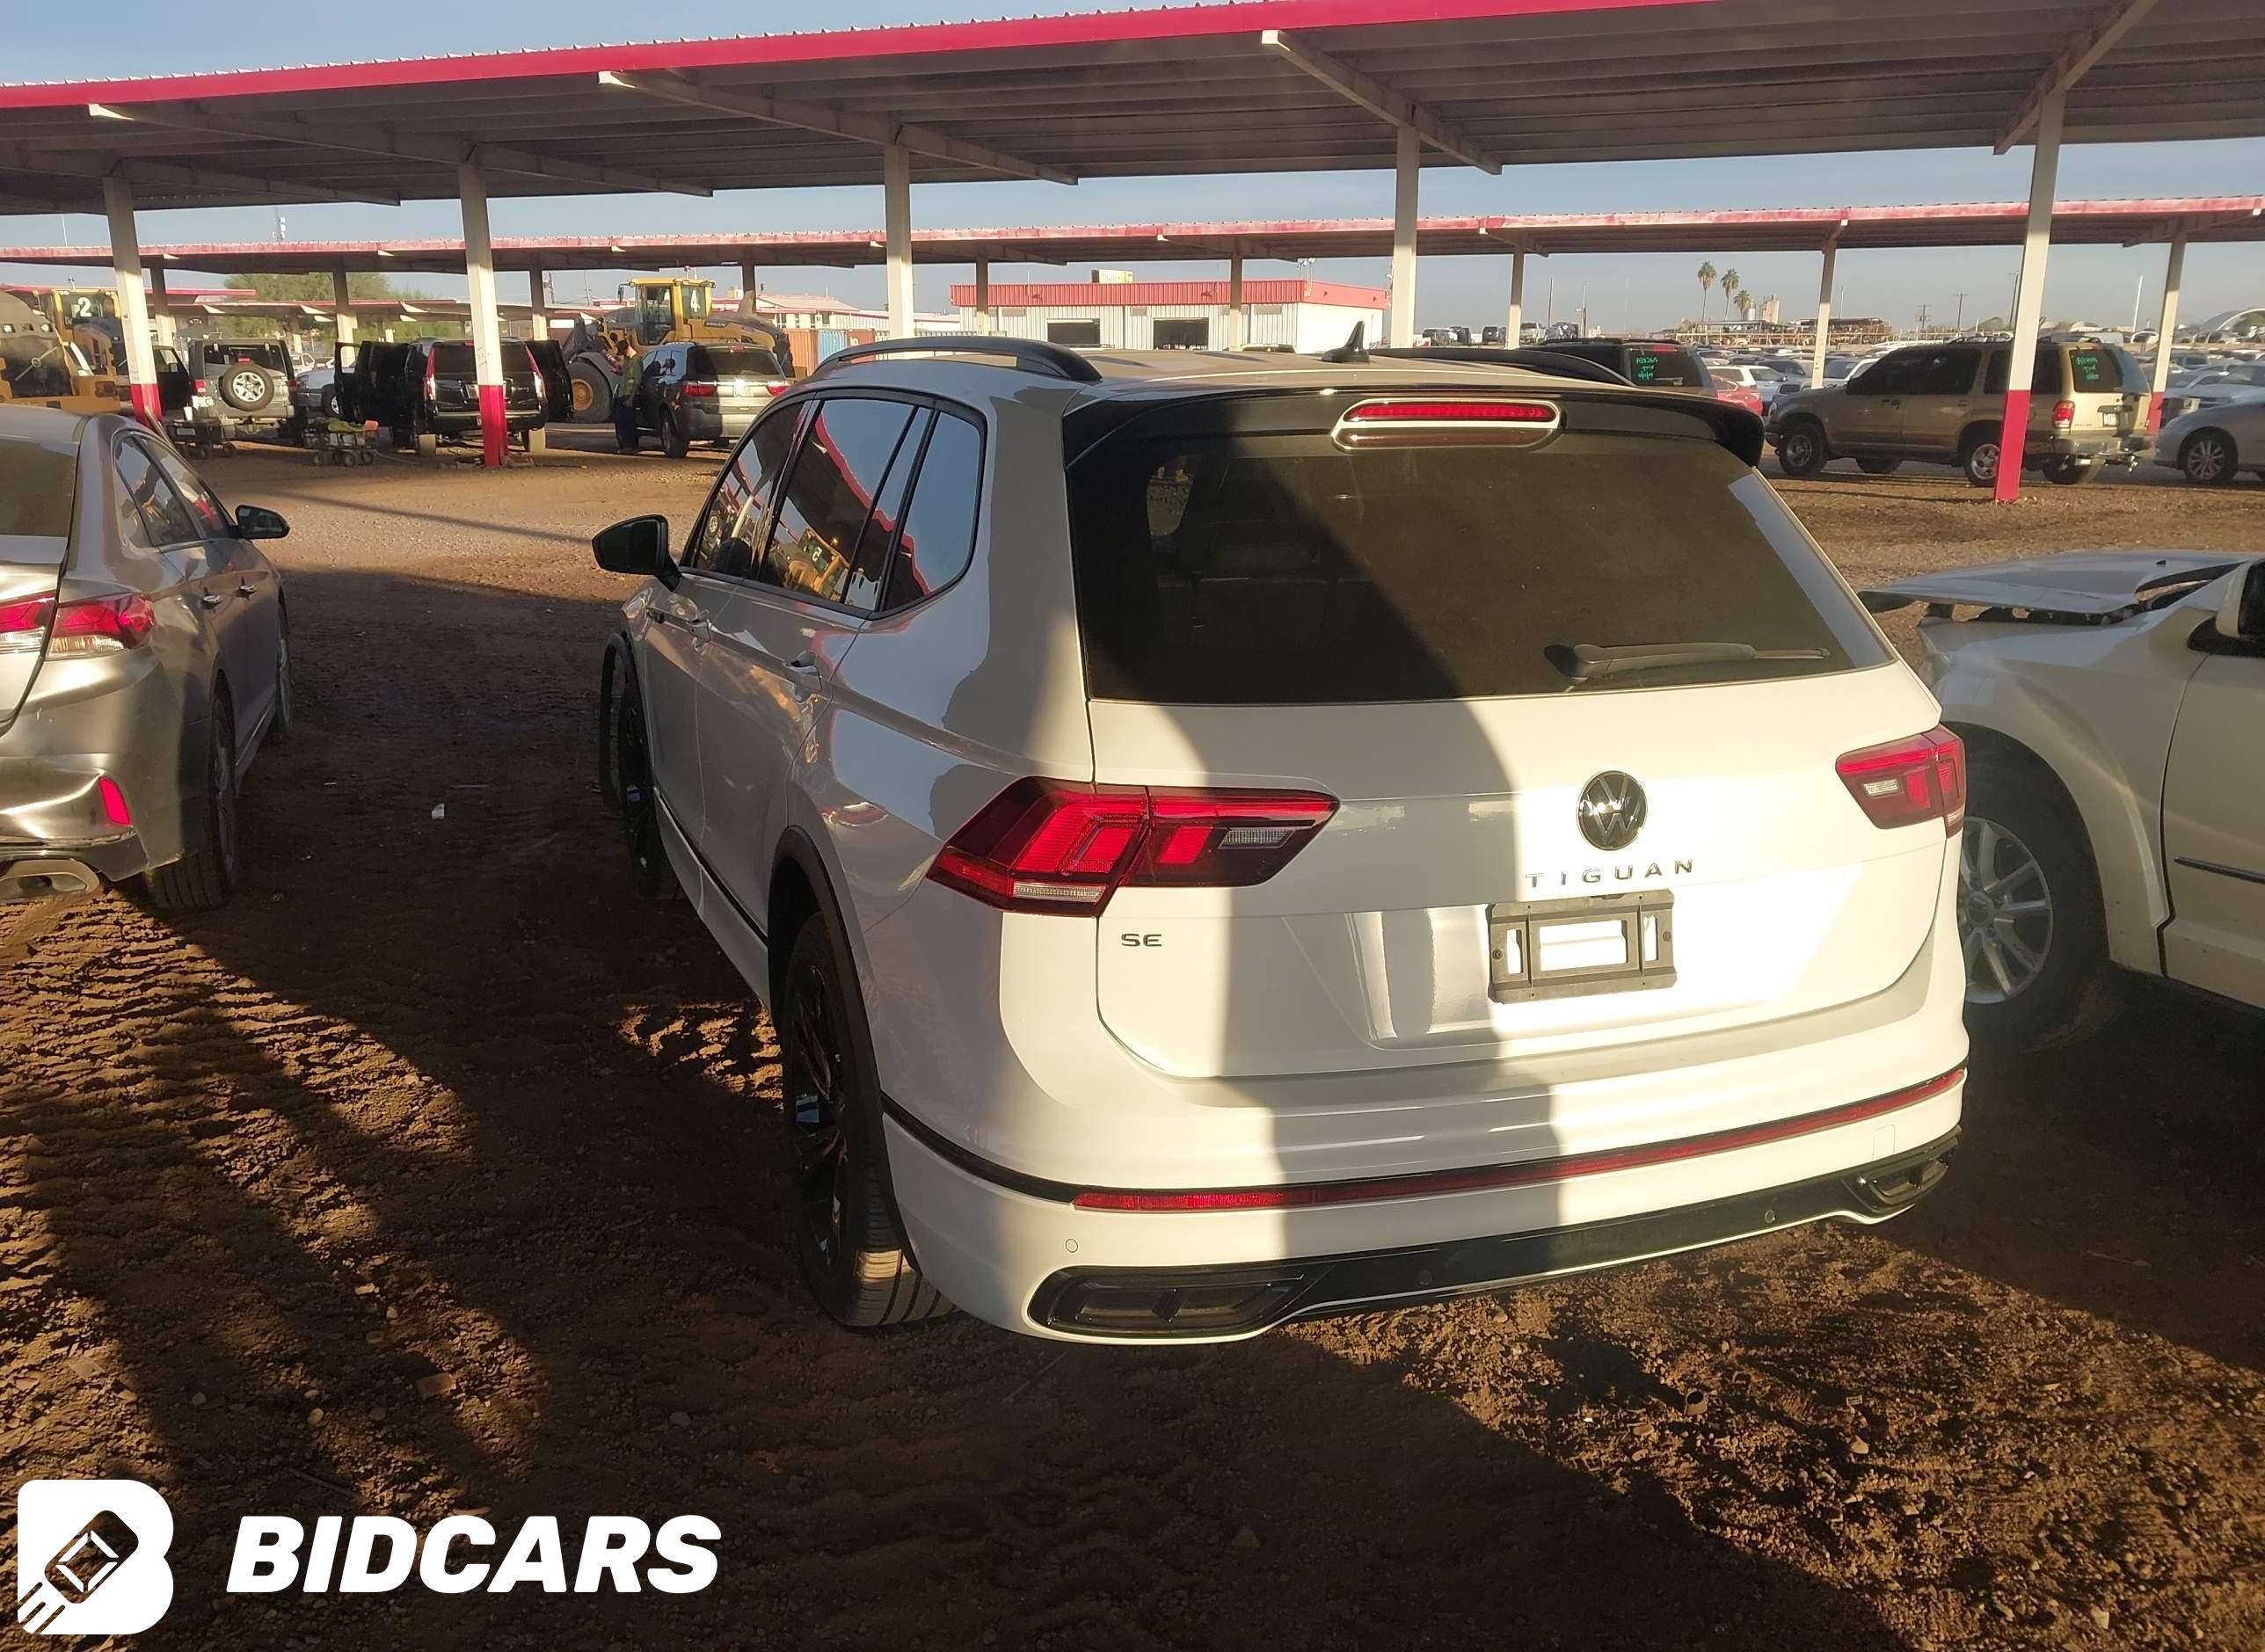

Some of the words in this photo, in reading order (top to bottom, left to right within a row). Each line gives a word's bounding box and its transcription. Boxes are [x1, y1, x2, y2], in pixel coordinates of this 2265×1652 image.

[77, 296, 92, 317] 2
[690, 288, 701, 313] 4
[1525, 858, 1693, 888] TIGUAN
[1120, 933, 1162, 947] SE
